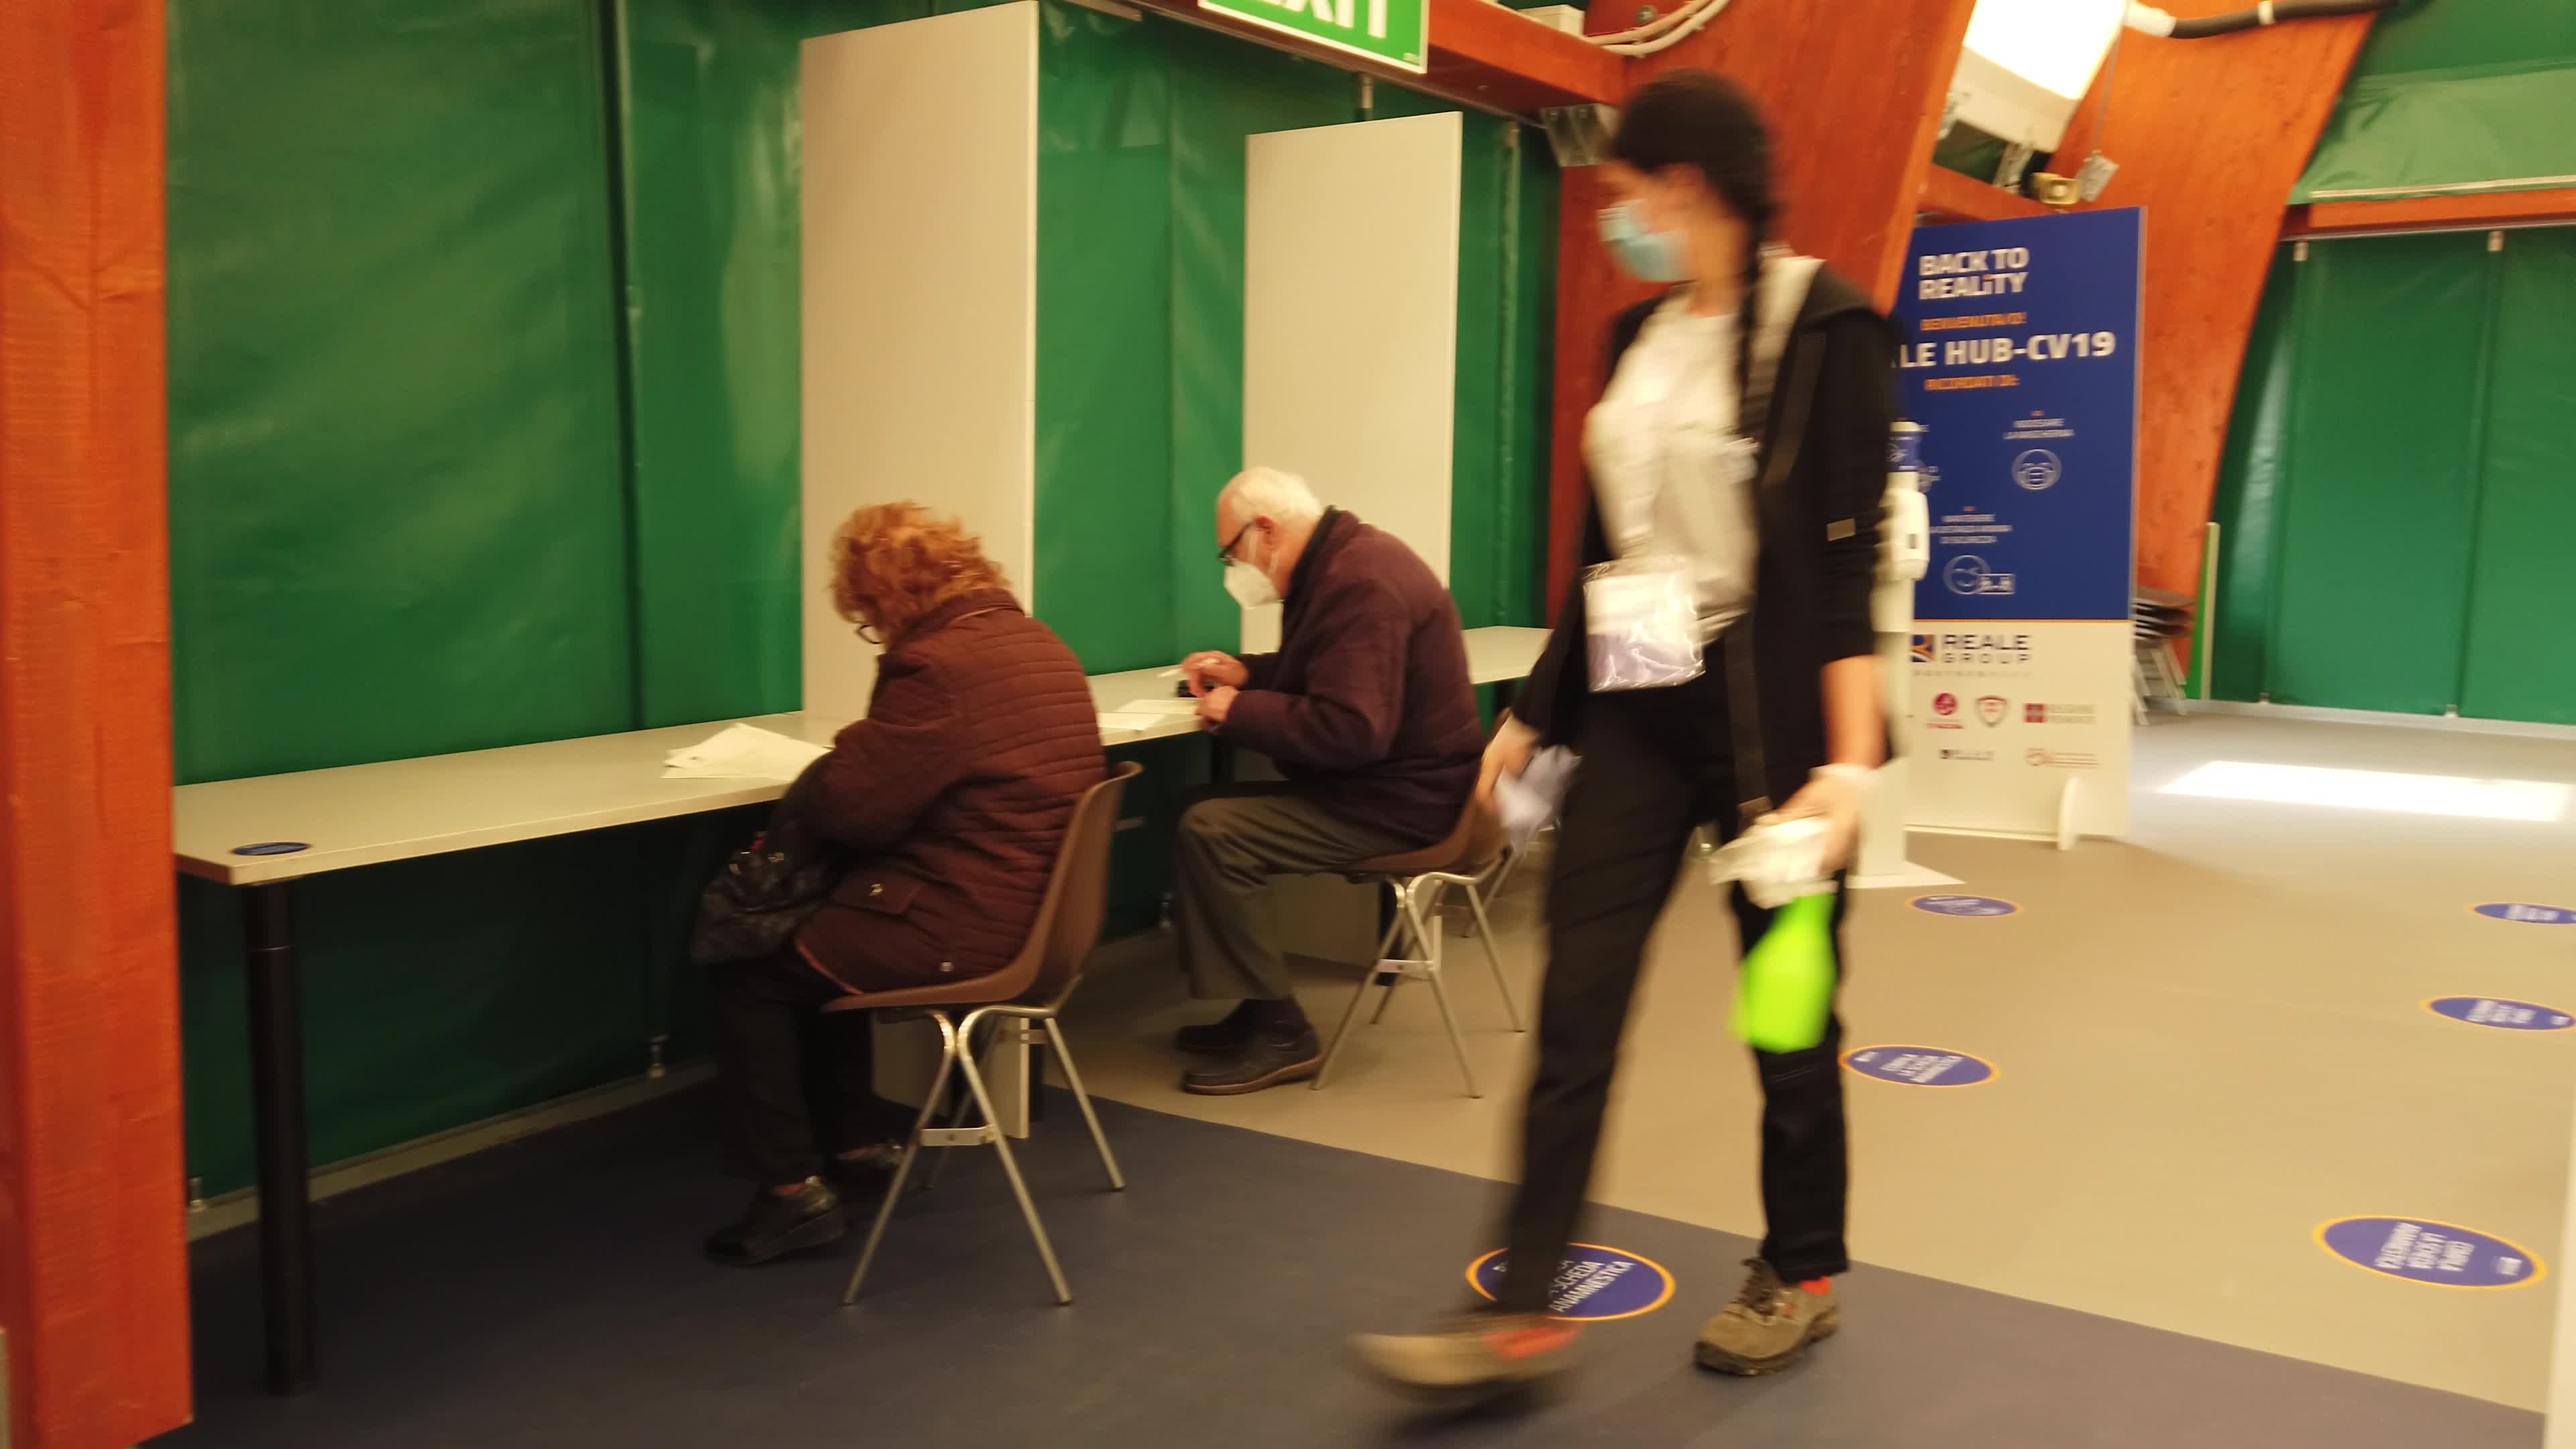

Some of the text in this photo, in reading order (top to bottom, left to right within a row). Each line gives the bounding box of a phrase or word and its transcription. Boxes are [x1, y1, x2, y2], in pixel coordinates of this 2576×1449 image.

[1919, 247, 2030, 276] BACK TO
[1891, 331, 2116, 368] LE HUB-CV19
[1943, 634, 2032, 650] REALE
[1943, 653, 2031, 664] GROUP
[1548, 1260, 1637, 1312] ANAMNESTICA
[1551, 1260, 1605, 1289] SCHEDA
